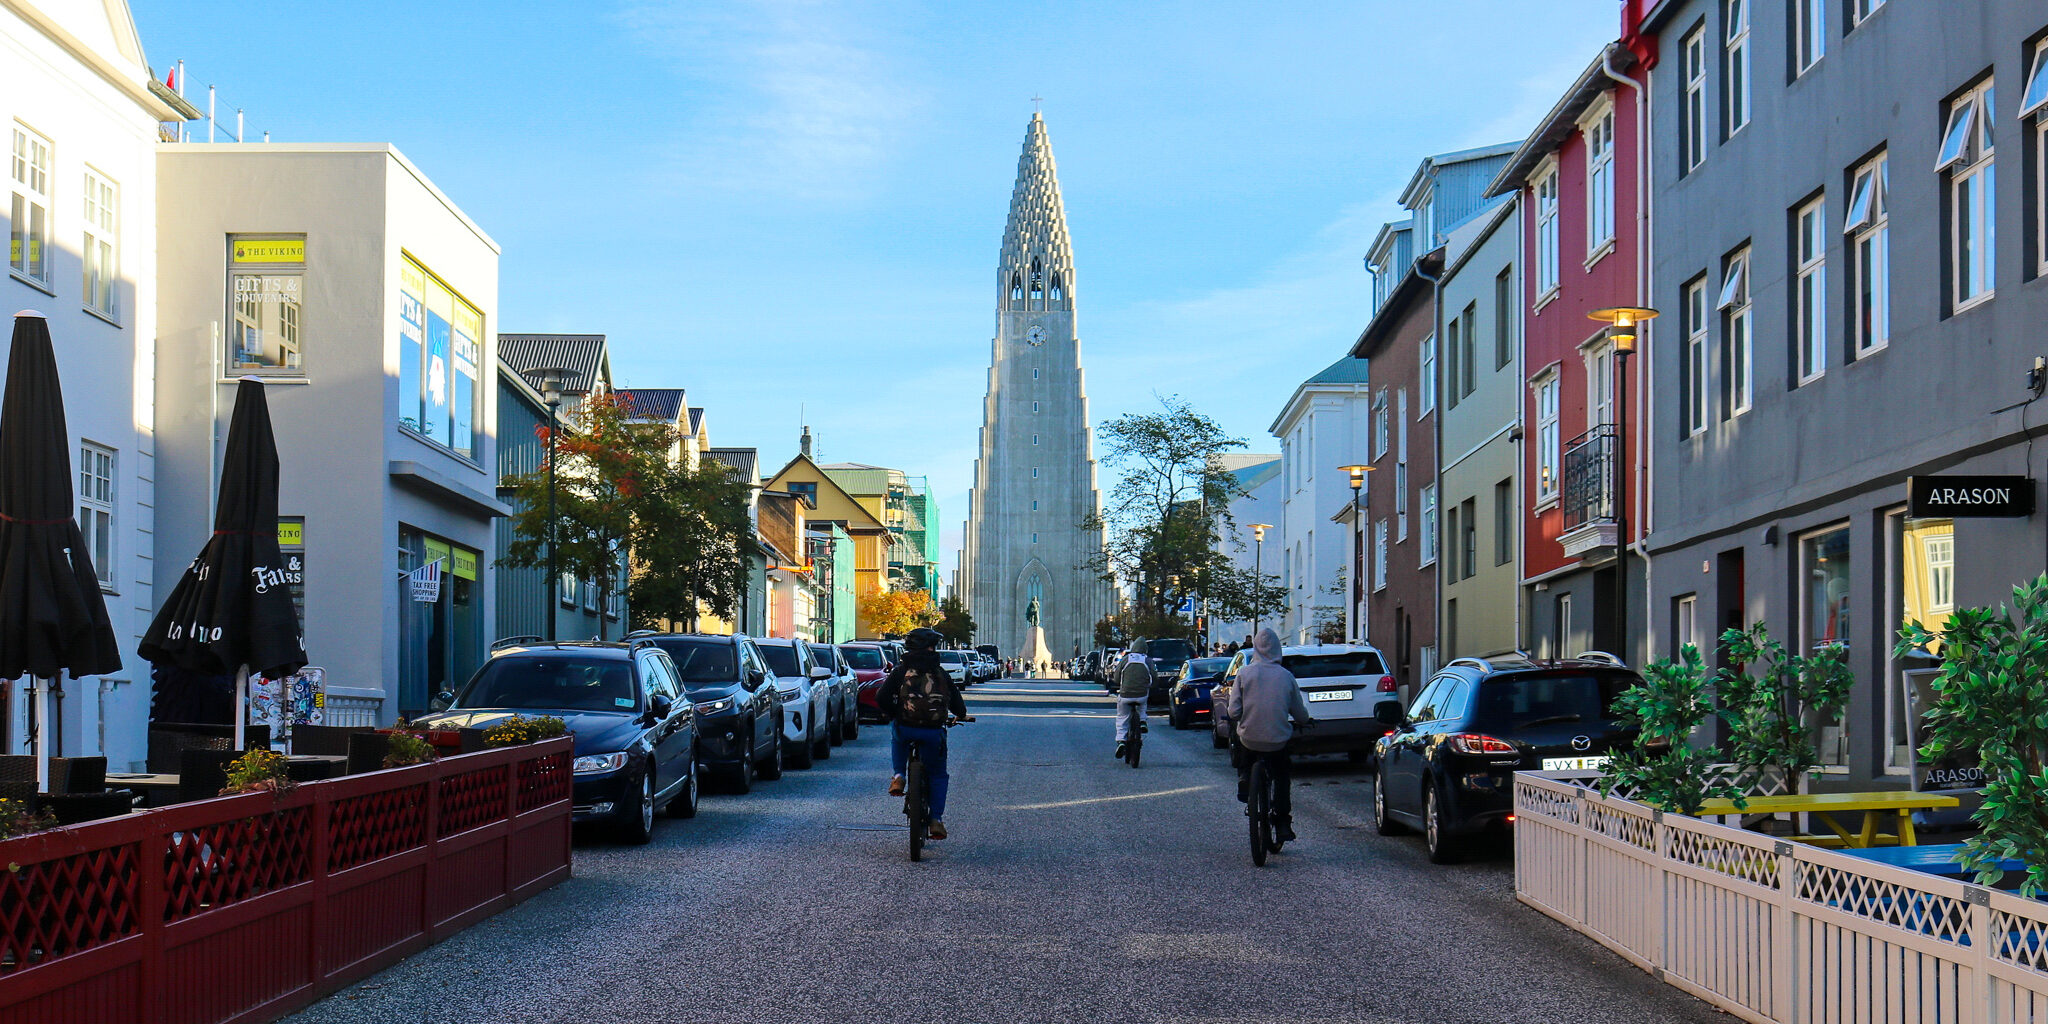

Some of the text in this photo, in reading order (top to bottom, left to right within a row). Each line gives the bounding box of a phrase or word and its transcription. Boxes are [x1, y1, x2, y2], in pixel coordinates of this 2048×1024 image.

[247, 248, 303, 256] THE VIKING
[236, 279, 298, 292] GIFTS &
[235, 293, 298, 304] SOUVENIRS
[1928, 488, 2010, 504] ARASON
[277, 529, 300, 538] KING
[413, 581, 437, 590] TAX FREE
[413, 589, 437, 597] SHOPPING
[1553, 760, 1573, 770] VX
